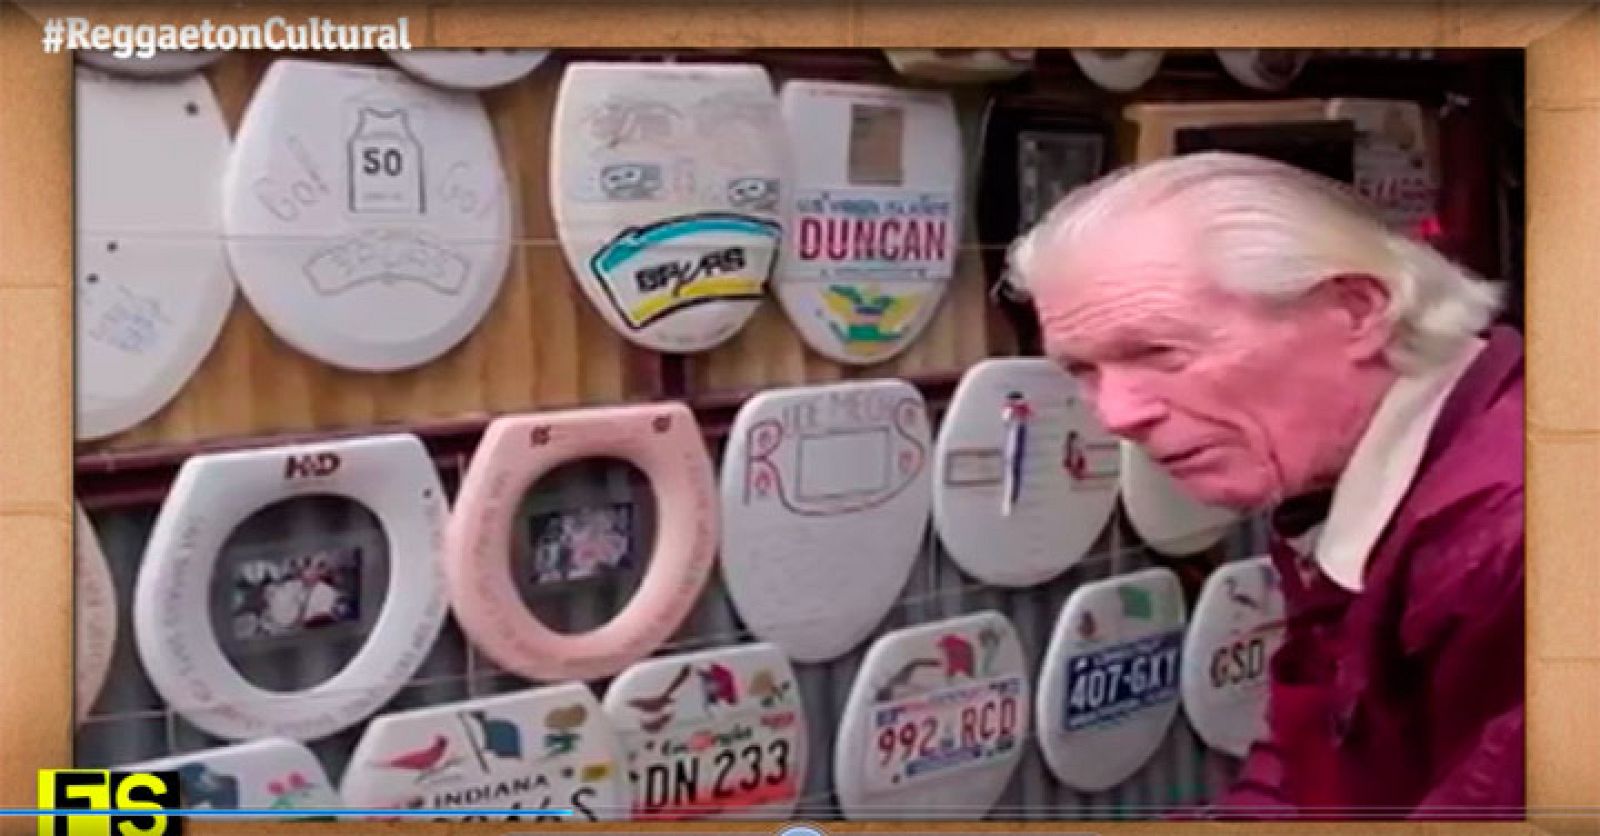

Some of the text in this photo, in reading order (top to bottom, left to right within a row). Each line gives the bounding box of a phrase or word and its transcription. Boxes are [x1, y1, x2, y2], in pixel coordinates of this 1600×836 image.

[362, 147, 402, 176] 50
[799, 215, 945, 262] DUNCAN
[879, 717, 938, 768] 992
[434, 775, 550, 807] INDIANA
[713, 738, 790, 799] 233
